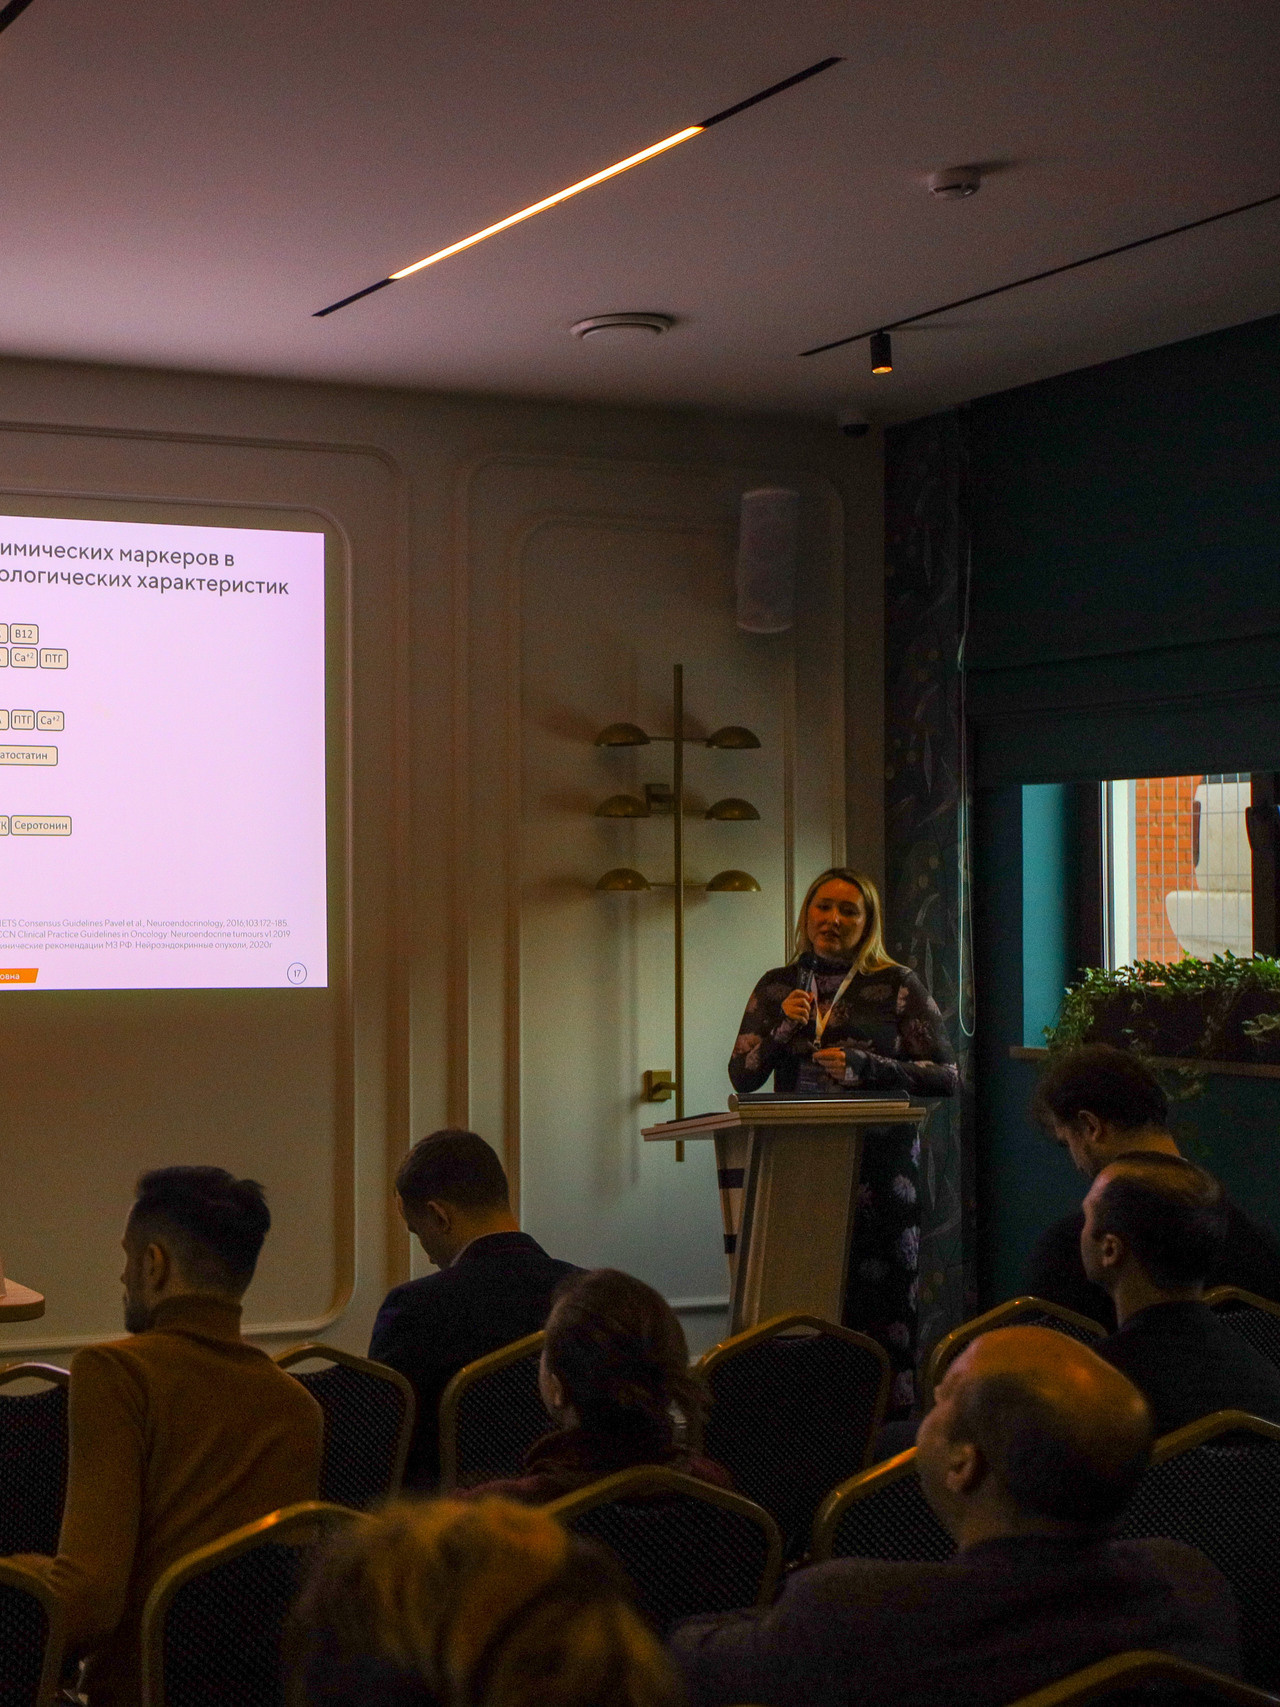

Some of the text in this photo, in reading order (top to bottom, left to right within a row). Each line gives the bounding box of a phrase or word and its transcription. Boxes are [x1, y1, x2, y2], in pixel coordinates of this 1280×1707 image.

[119, 548, 219, 569] маркеров
[225, 553, 234, 566] в
[137, 575, 289, 596] характеристик
[45, 653, 63, 664] ПТГ
[14, 714, 32, 725] ПТГ
[14, 820, 68, 833] Серотонин
[18, 919, 61, 927] Consensus
[62, 919, 103, 927] Guidelines
[104, 919, 125, 927] Pavel
[18, 930, 45, 938] Clinical
[47, 930, 78, 938] Practice
[80, 930, 120, 938] Guidelines
[45, 942, 104, 951] рекомендации
[135, 940, 213, 950] Нейроэндокринные
[294, 969, 301, 978] 17
